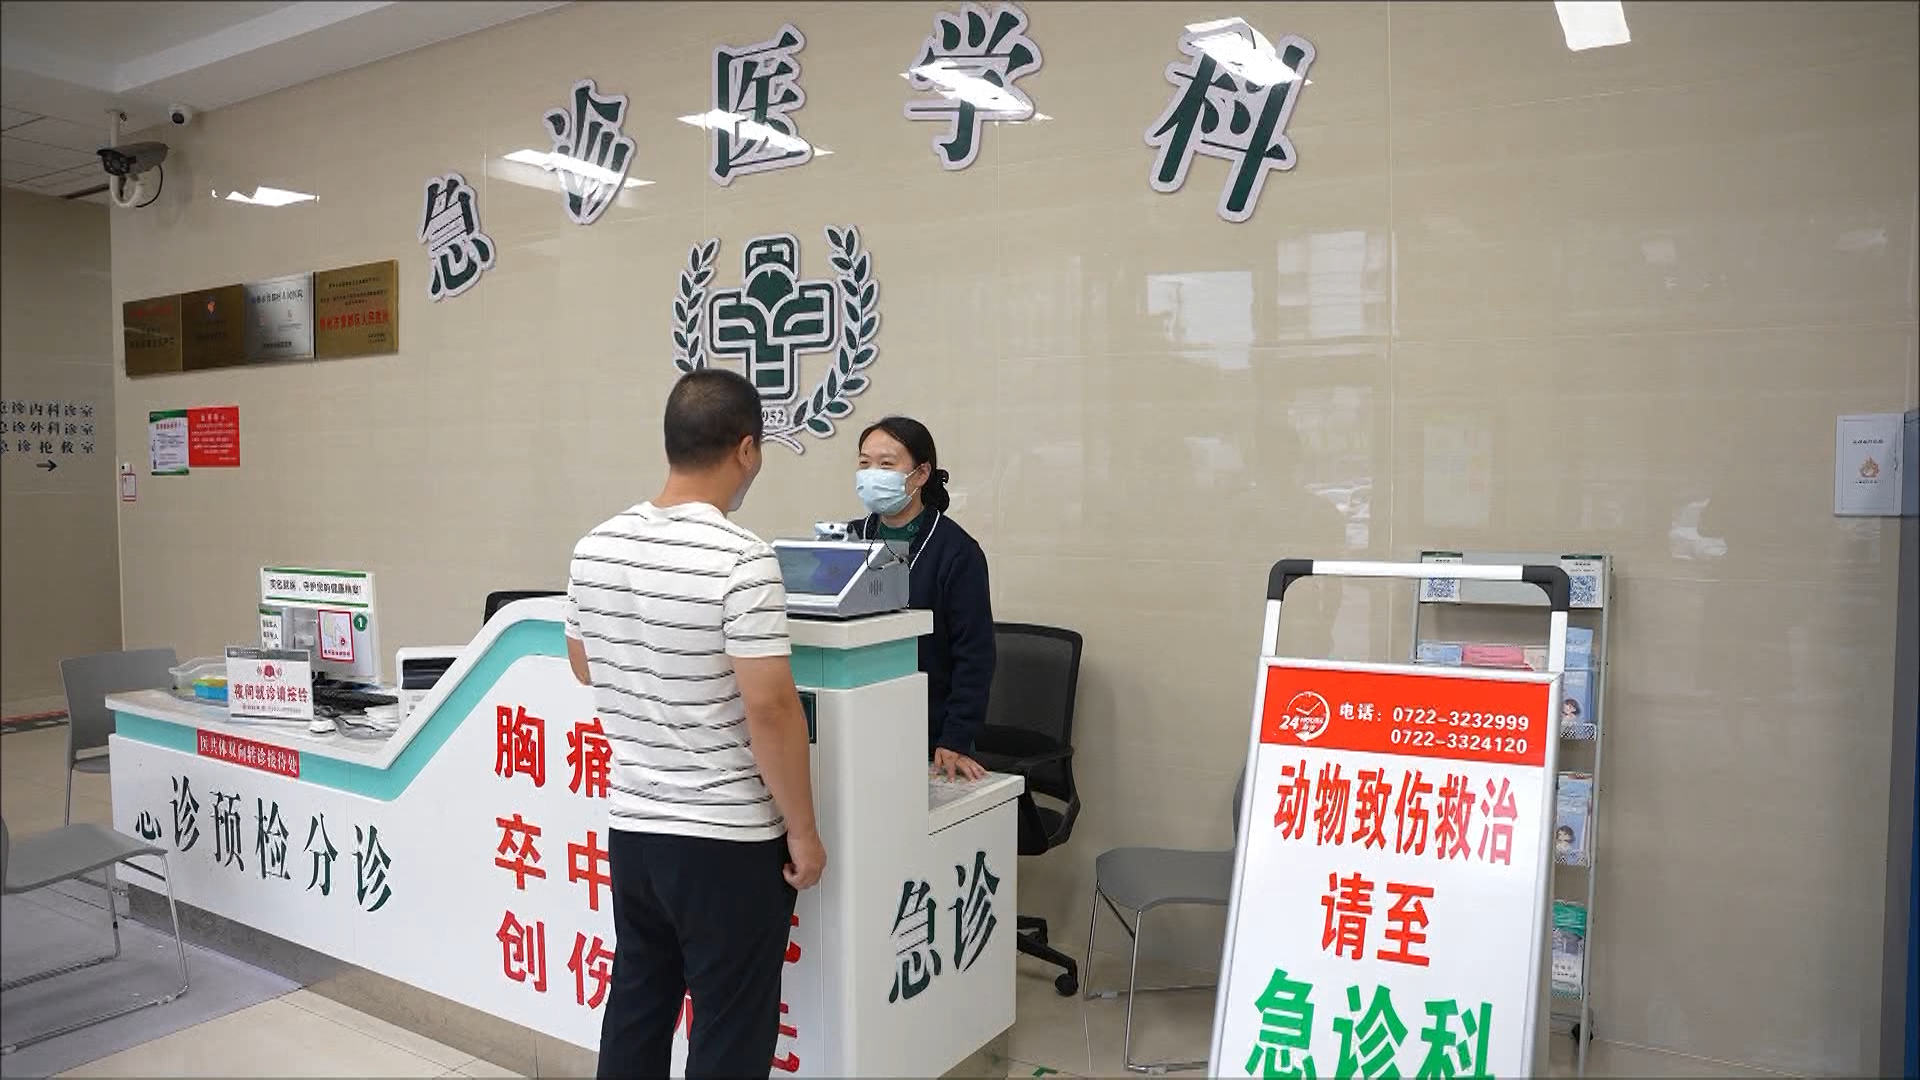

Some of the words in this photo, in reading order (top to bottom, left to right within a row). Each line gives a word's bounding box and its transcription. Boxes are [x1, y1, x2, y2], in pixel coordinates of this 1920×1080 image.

[418, 8, 1308, 298] 急诊医学科
[200, 735, 297, 774] 医共体双向转诊接待处
[1390, 728, 1528, 754] 0722-3324120
[1273, 759, 1518, 866] 动物致伤救治
[888, 850, 1000, 1004] 急诊
[1320, 871, 1434, 968] 请至
[1244, 967, 1496, 1079] 急诊科
